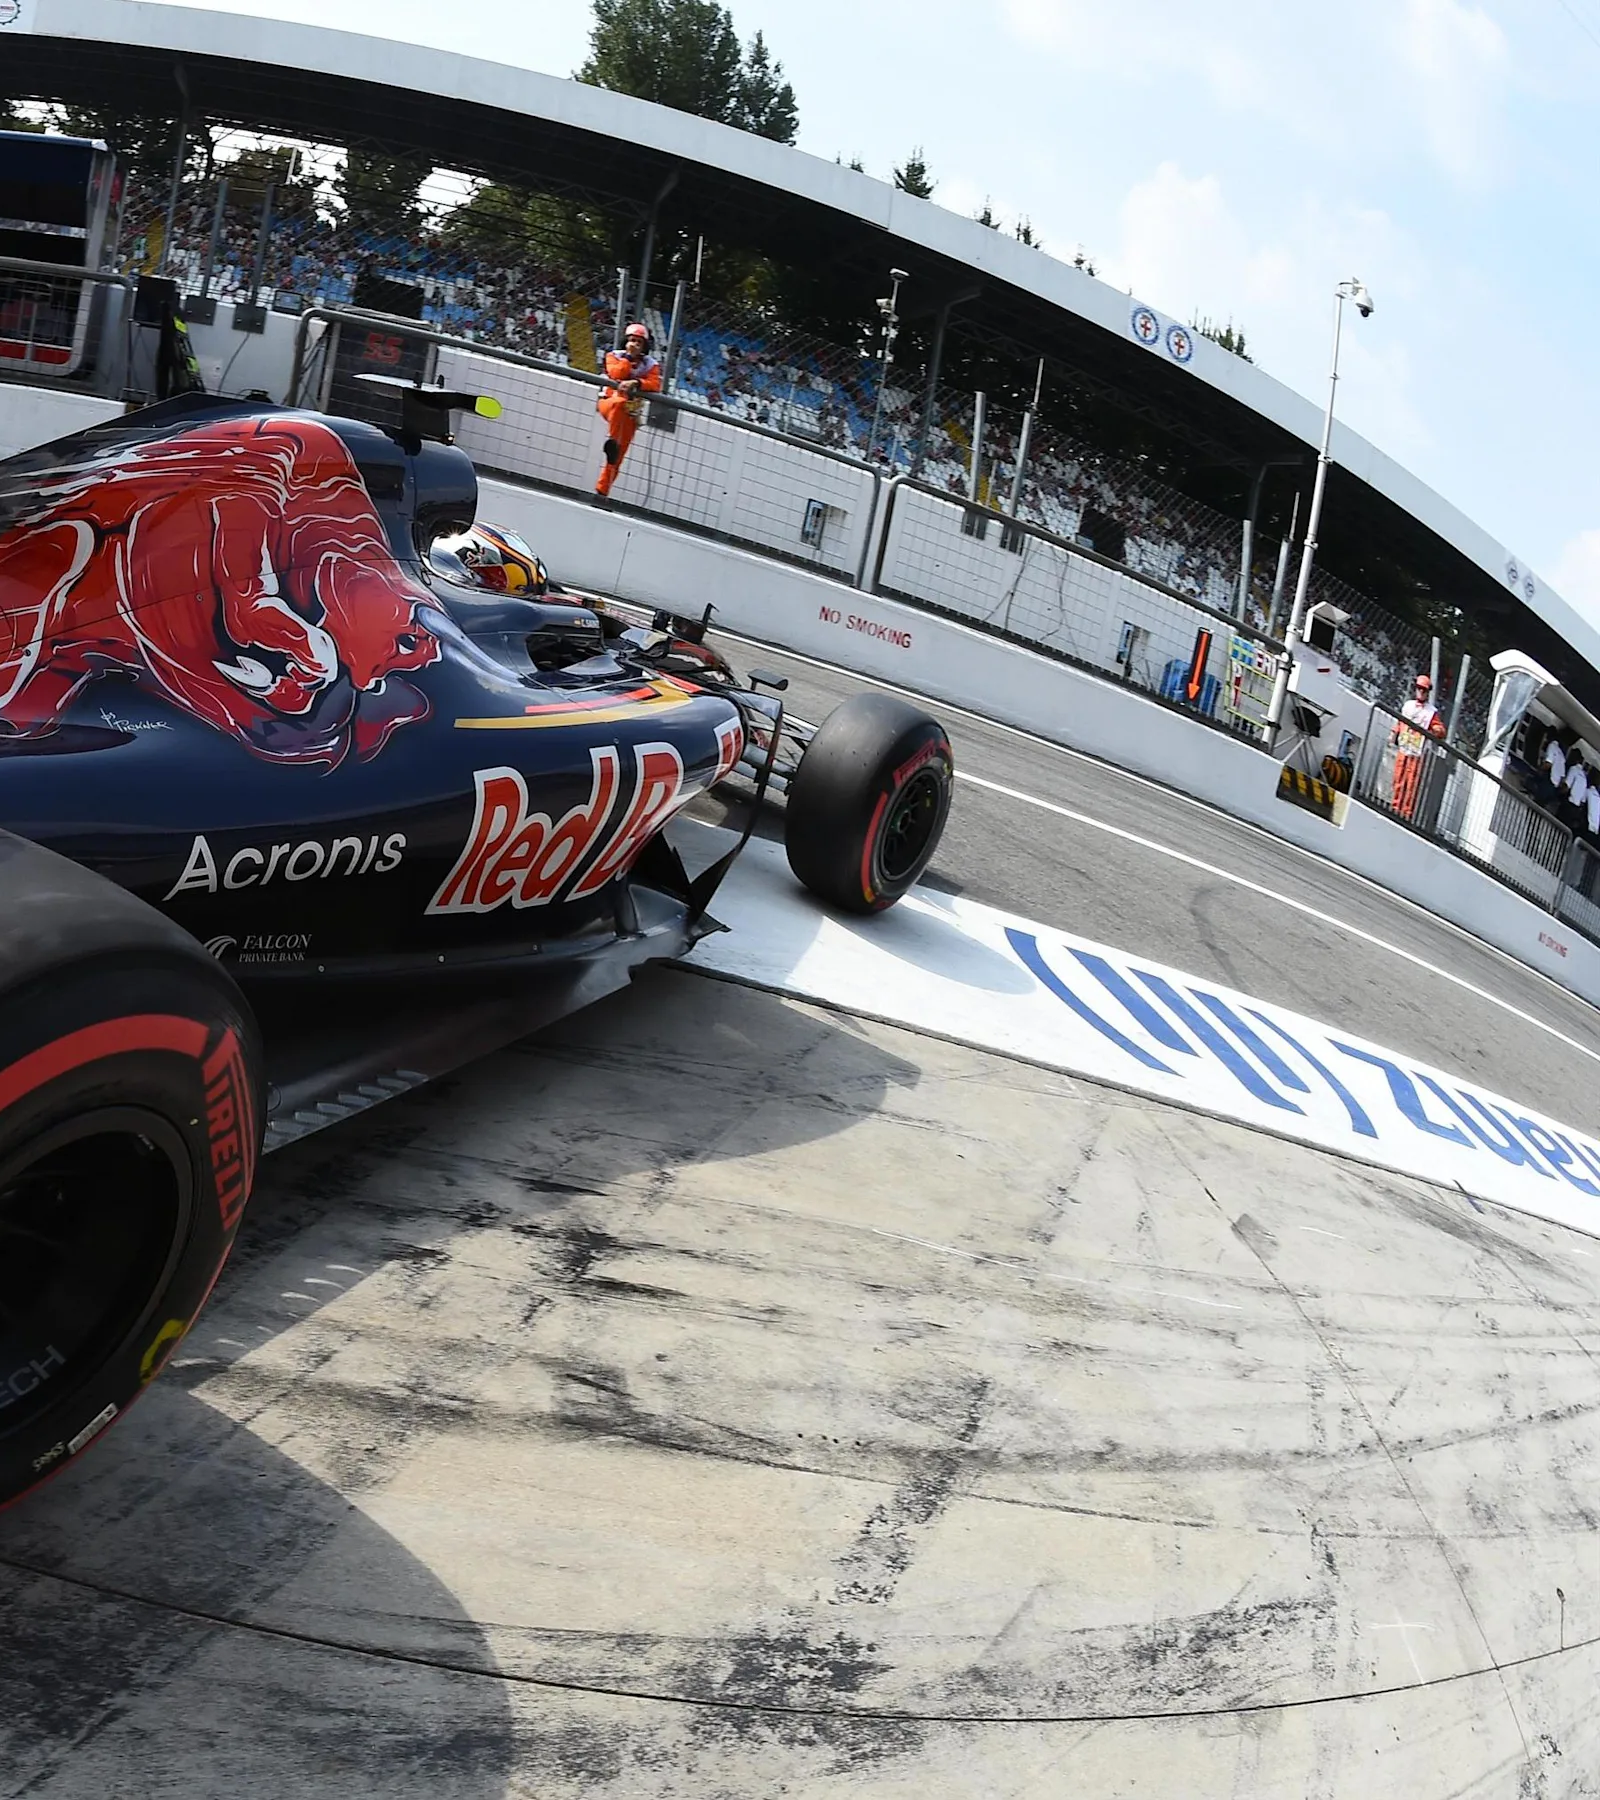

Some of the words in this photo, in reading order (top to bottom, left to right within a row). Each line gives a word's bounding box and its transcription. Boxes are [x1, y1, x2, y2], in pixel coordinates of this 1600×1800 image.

[362, 332, 404, 364] 55
[819, 606, 841, 624] NO
[846, 615, 912, 648] SMOKING
[425, 746, 620, 915] Red
[164, 832, 406, 900] Acronis
[239, 953, 278, 962] PRIVATE
[279, 952, 305, 962] BANK
[242, 934, 312, 949] FALCON
[202, 1027, 255, 1232] PIRELLI
